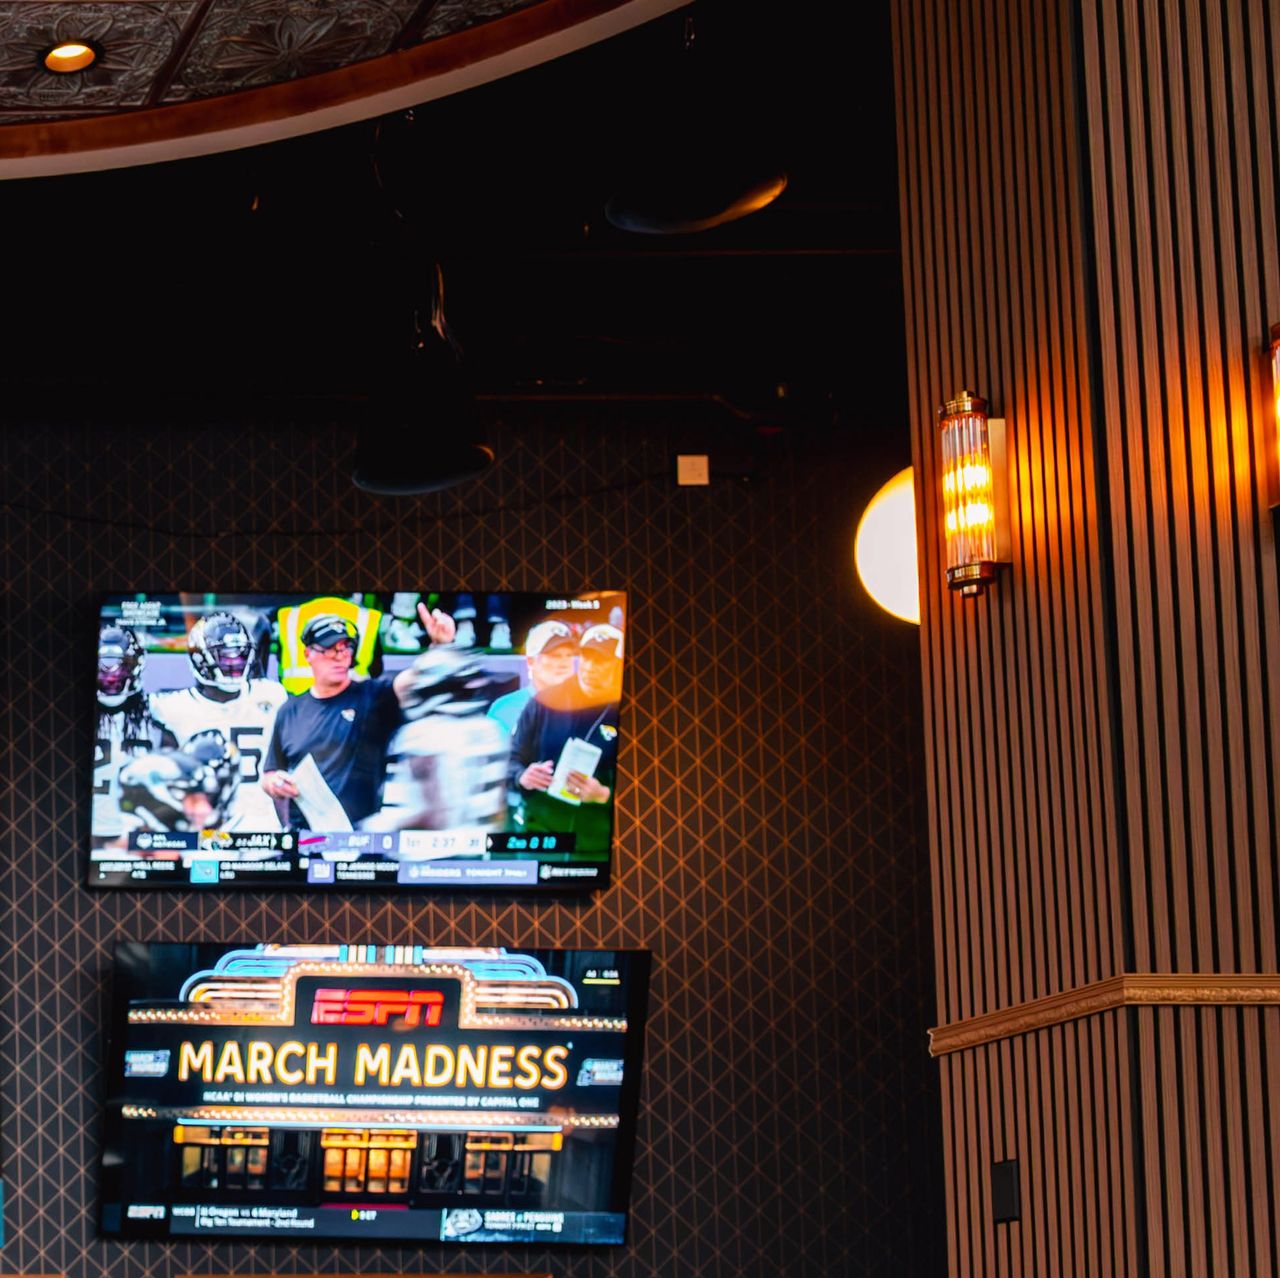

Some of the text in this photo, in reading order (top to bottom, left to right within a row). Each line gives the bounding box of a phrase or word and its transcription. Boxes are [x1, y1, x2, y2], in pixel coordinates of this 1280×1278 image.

[250, 834, 269, 847] JAX
[311, 988, 444, 1026] ESPN
[178, 1040, 338, 1085] MARCH
[289, 1093, 345, 1104] BASKETBALL
[346, 1094, 414, 1105] CHAMPIONSHIP
[414, 1095, 466, 1106] PRESENTED
[467, 1096, 480, 1107] BY
[481, 1097, 518, 1108] CAPITAL
[518, 1097, 539, 1108] ONE
[209, 1207, 239, 1219] Oregon
[258, 1207, 298, 1220] Maryland
[228, 1218, 270, 1228] Tournament
